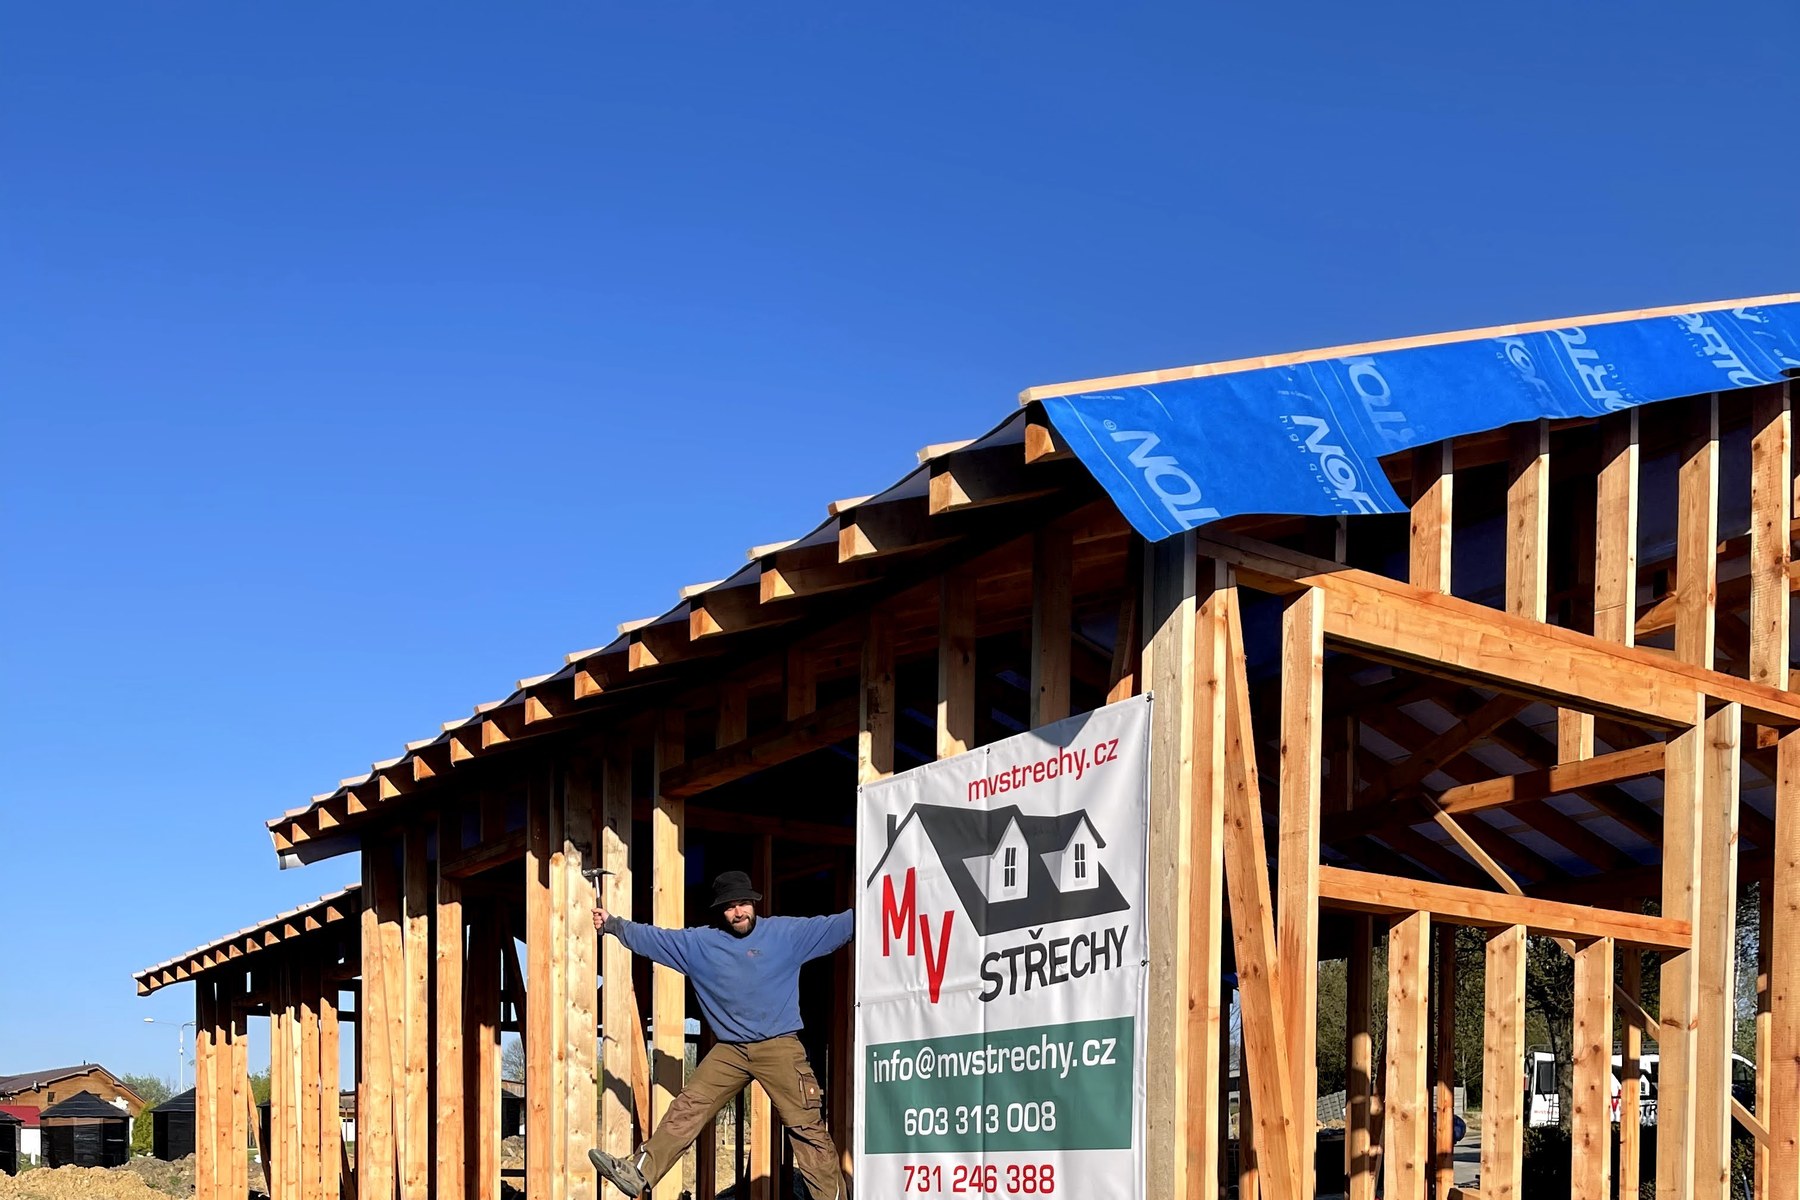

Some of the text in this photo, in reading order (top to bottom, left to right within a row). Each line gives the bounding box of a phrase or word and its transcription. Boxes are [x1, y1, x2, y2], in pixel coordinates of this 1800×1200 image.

[1280, 415, 1307, 455] high
[968, 738, 1119, 802] mvstrechy.cz
[882, 866, 955, 1004] MV
[978, 925, 1129, 1003] STŘECHY
[873, 1034, 1117, 1083] info@mvstrechy.cz
[904, 1101, 1056, 1136] 603 313 008
[903, 1164, 1055, 1194] 731 246 388
